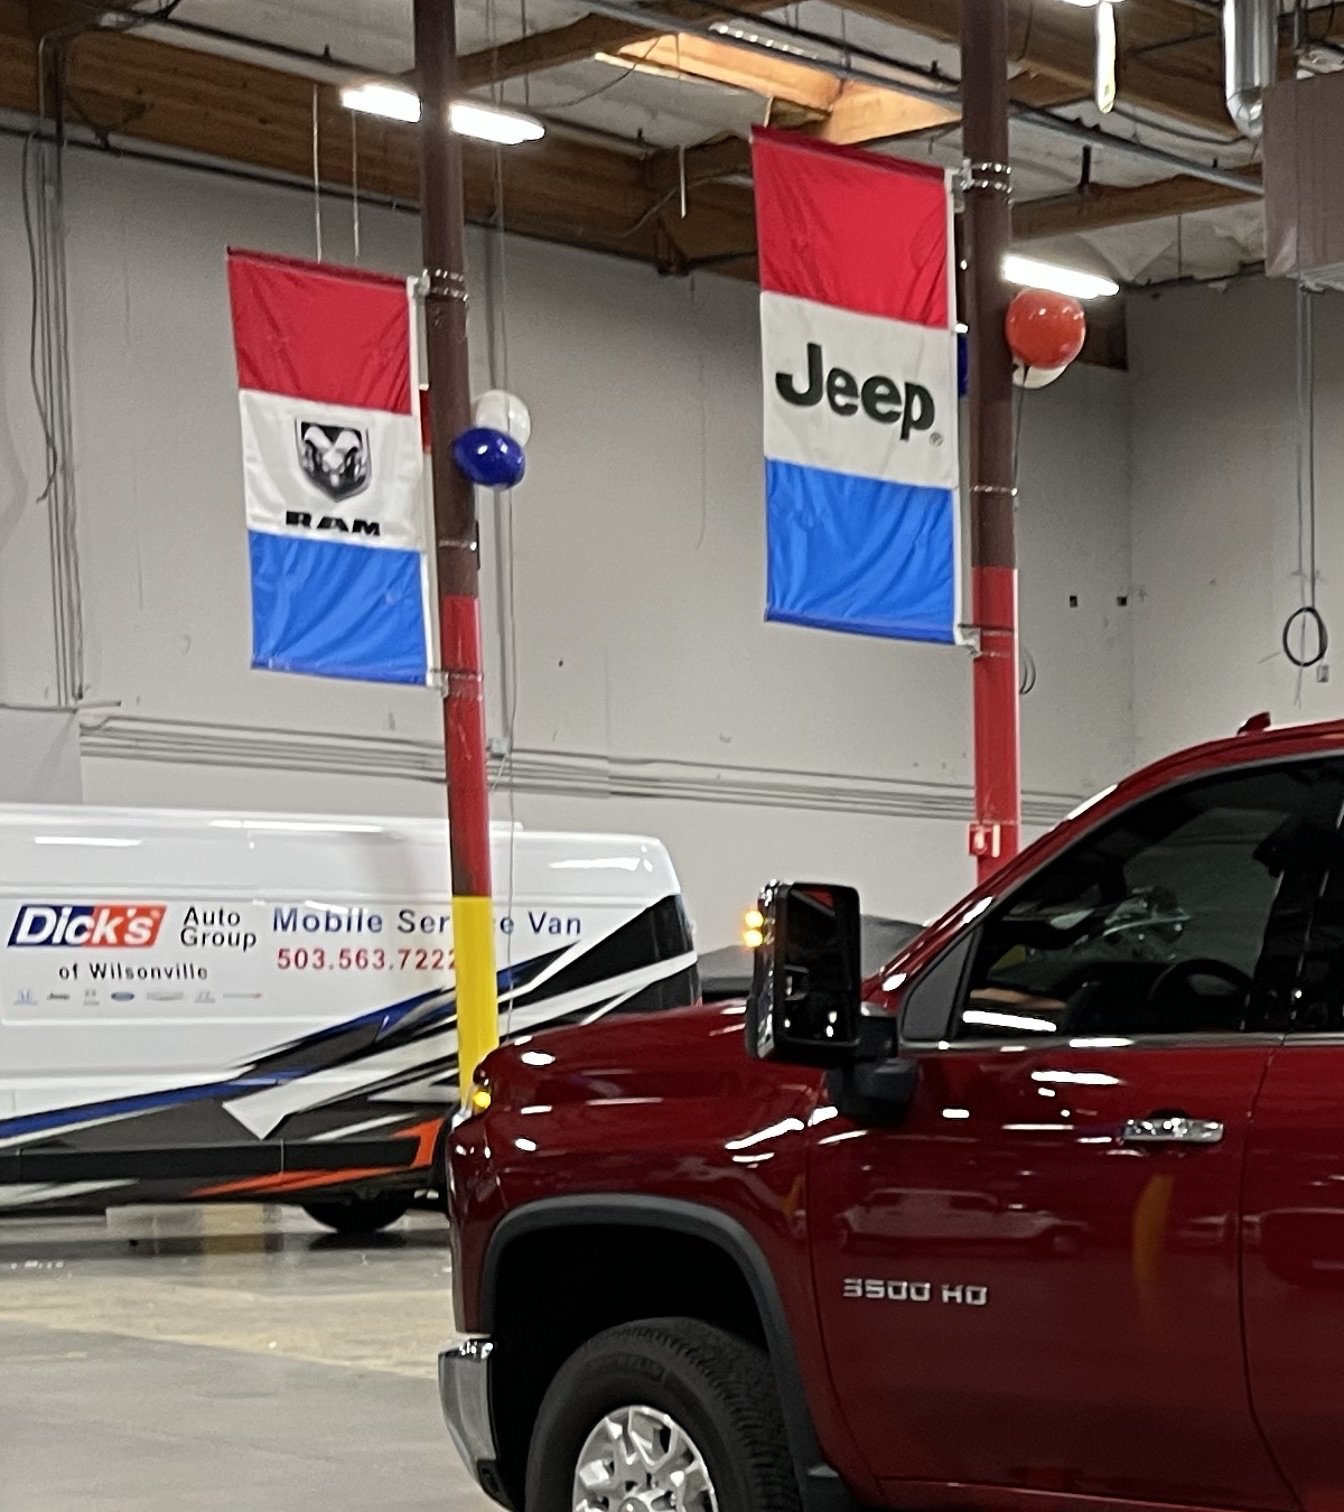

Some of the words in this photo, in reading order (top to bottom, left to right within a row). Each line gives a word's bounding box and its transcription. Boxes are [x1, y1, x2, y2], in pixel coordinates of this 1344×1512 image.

[775, 342, 935, 442] Jeep
[286, 511, 380, 536] RAM
[15, 906, 155, 945] Dick's
[184, 906, 241, 926] Auto
[272, 906, 383, 934] Mobile
[528, 911, 582, 935] Van
[180, 927, 257, 952] Group
[58, 963, 78, 980] of
[89, 963, 208, 981] Wilsonville
[843, 1278, 930, 1302] 3500
[941, 1284, 987, 1306] HD
